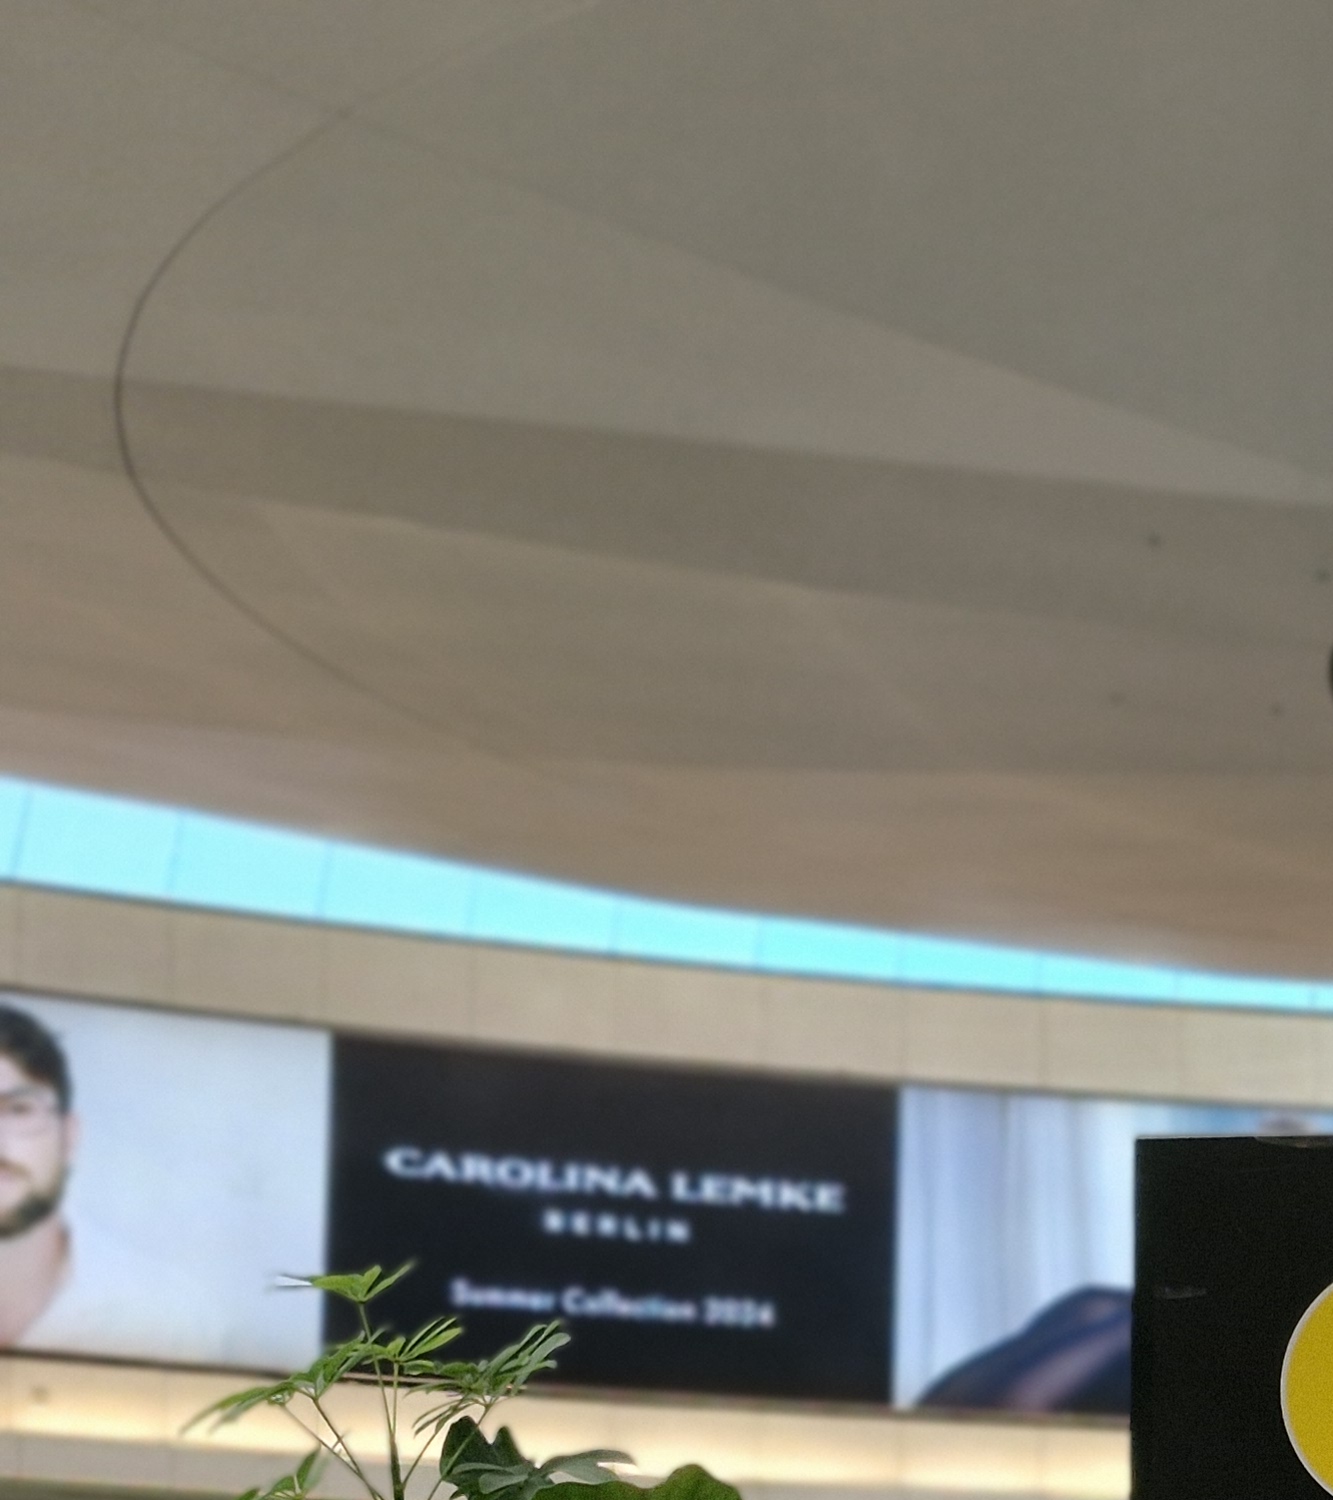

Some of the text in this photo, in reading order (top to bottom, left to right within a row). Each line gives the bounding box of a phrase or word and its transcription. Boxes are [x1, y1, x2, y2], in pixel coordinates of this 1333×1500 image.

[385, 1145, 845, 1214] CAROLINA LEMKE
[541, 1208, 690, 1243] BERLIN
